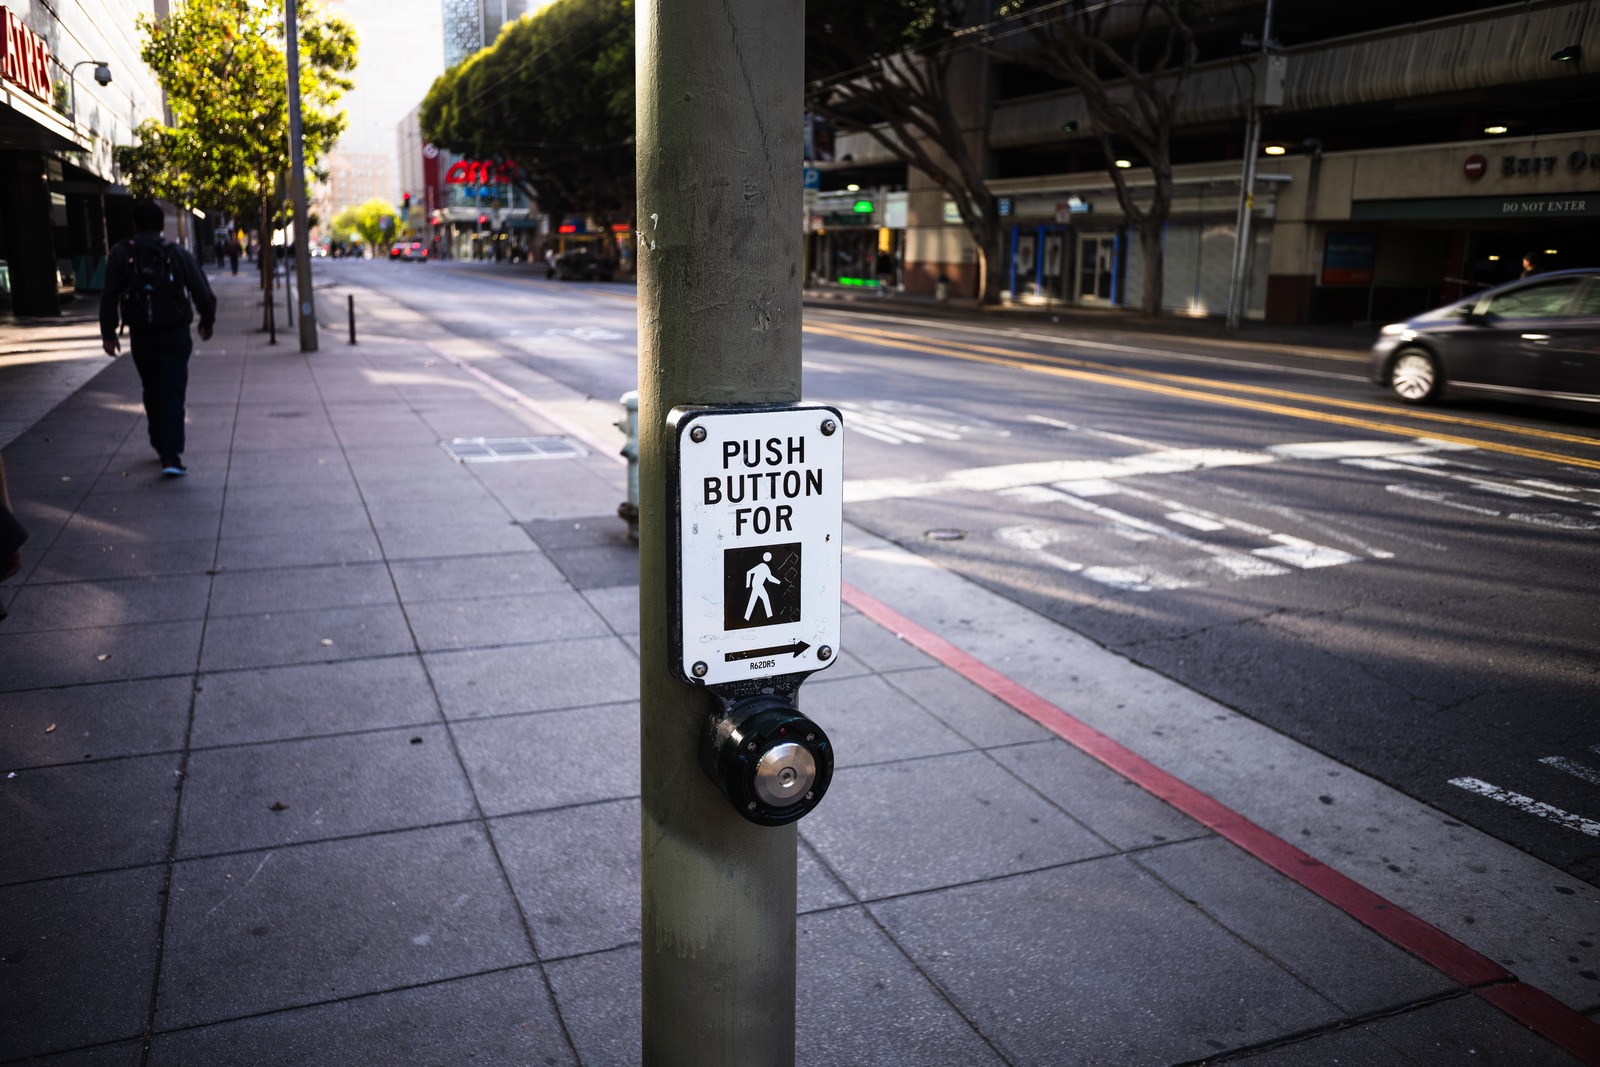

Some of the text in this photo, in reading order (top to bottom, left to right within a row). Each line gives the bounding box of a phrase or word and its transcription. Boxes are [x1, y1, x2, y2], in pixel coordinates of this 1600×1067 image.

[1502, 200, 1586, 212] DO NOT ENTER
[723, 436, 805, 469] PUSH
[703, 468, 823, 505] BUTTON
[735, 504, 793, 536] FOR
[750, 659, 776, 670] R62DR5
